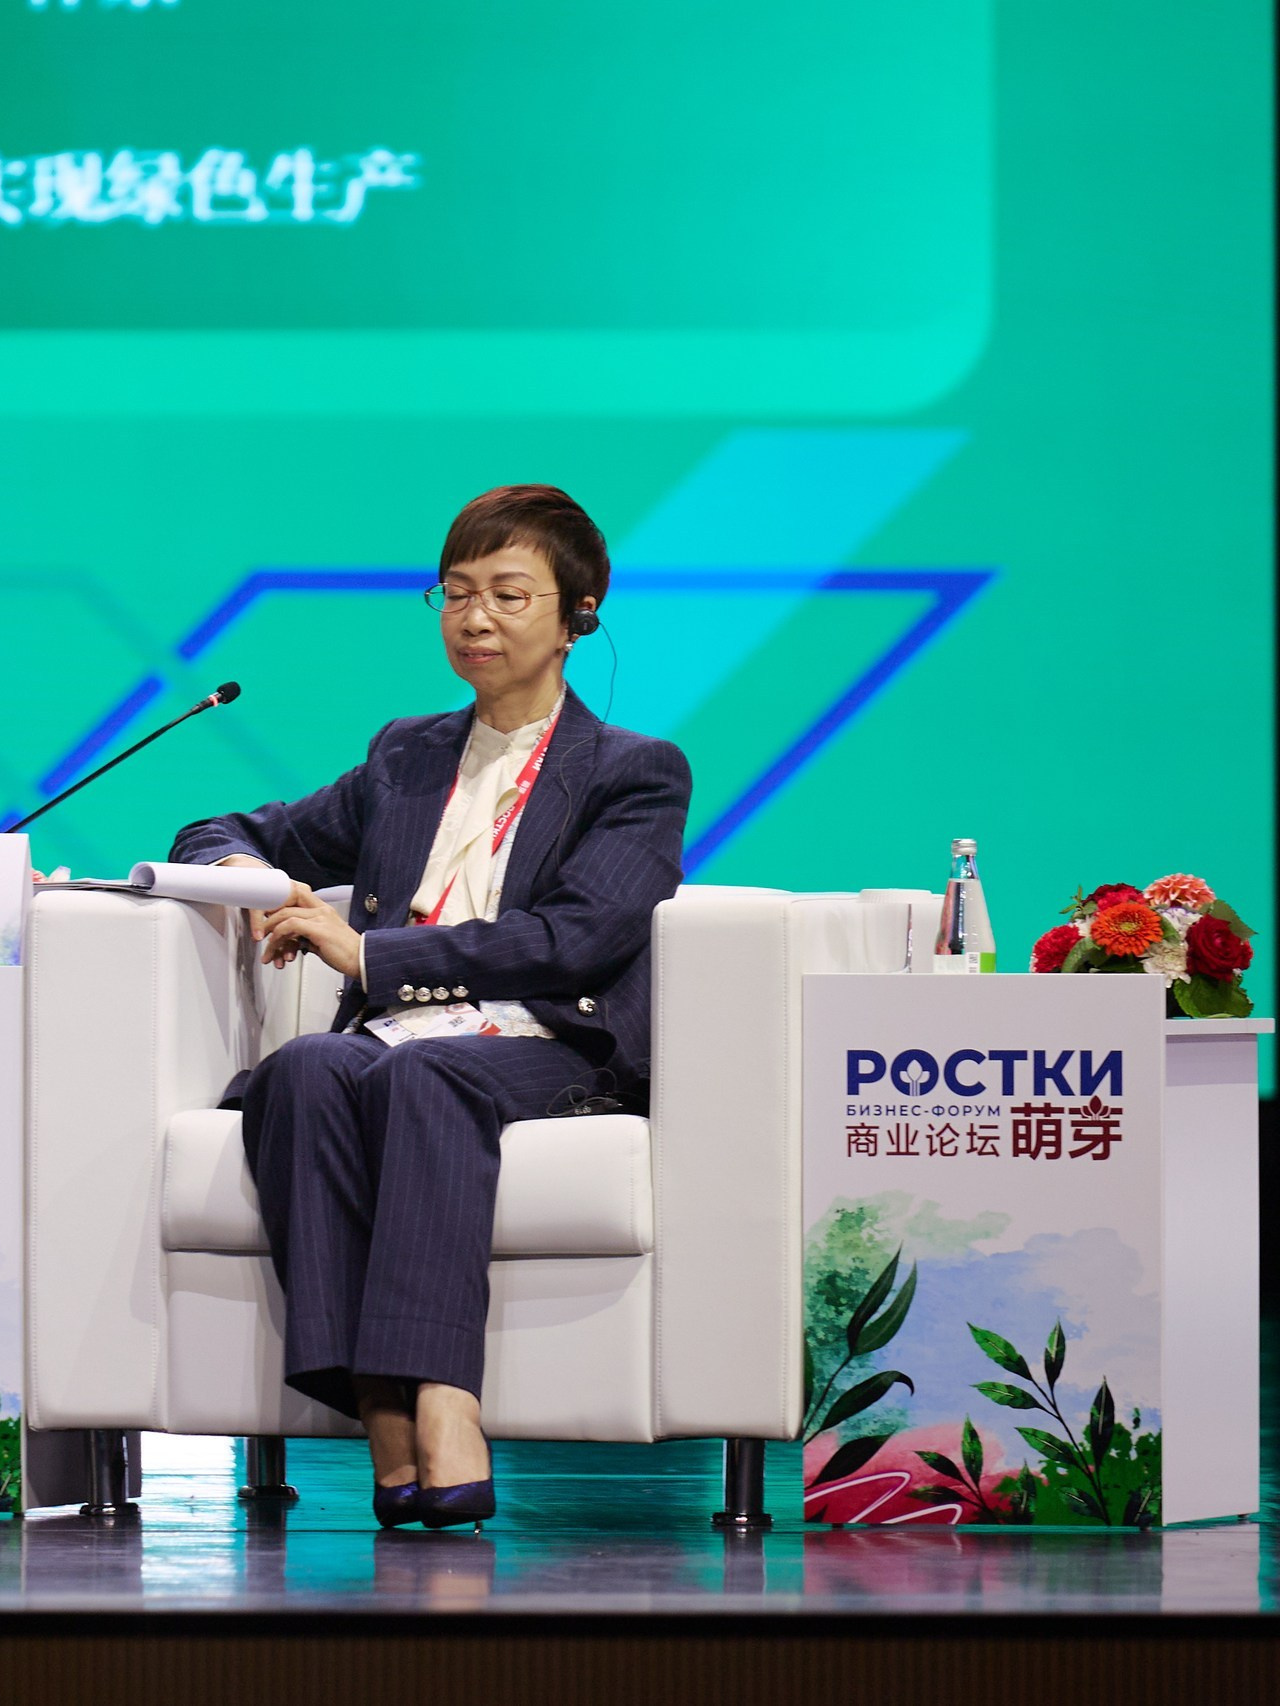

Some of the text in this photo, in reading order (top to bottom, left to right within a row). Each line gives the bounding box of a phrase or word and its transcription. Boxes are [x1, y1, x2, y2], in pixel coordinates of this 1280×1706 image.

[846, 1048, 1124, 1097] РОСТКИ
[846, 1104, 1001, 1117] БИЗНЕС-ФОРУМ
[1010, 1095, 1124, 1161] 萌芽
[845, 1121, 1001, 1158] 商业论坛
